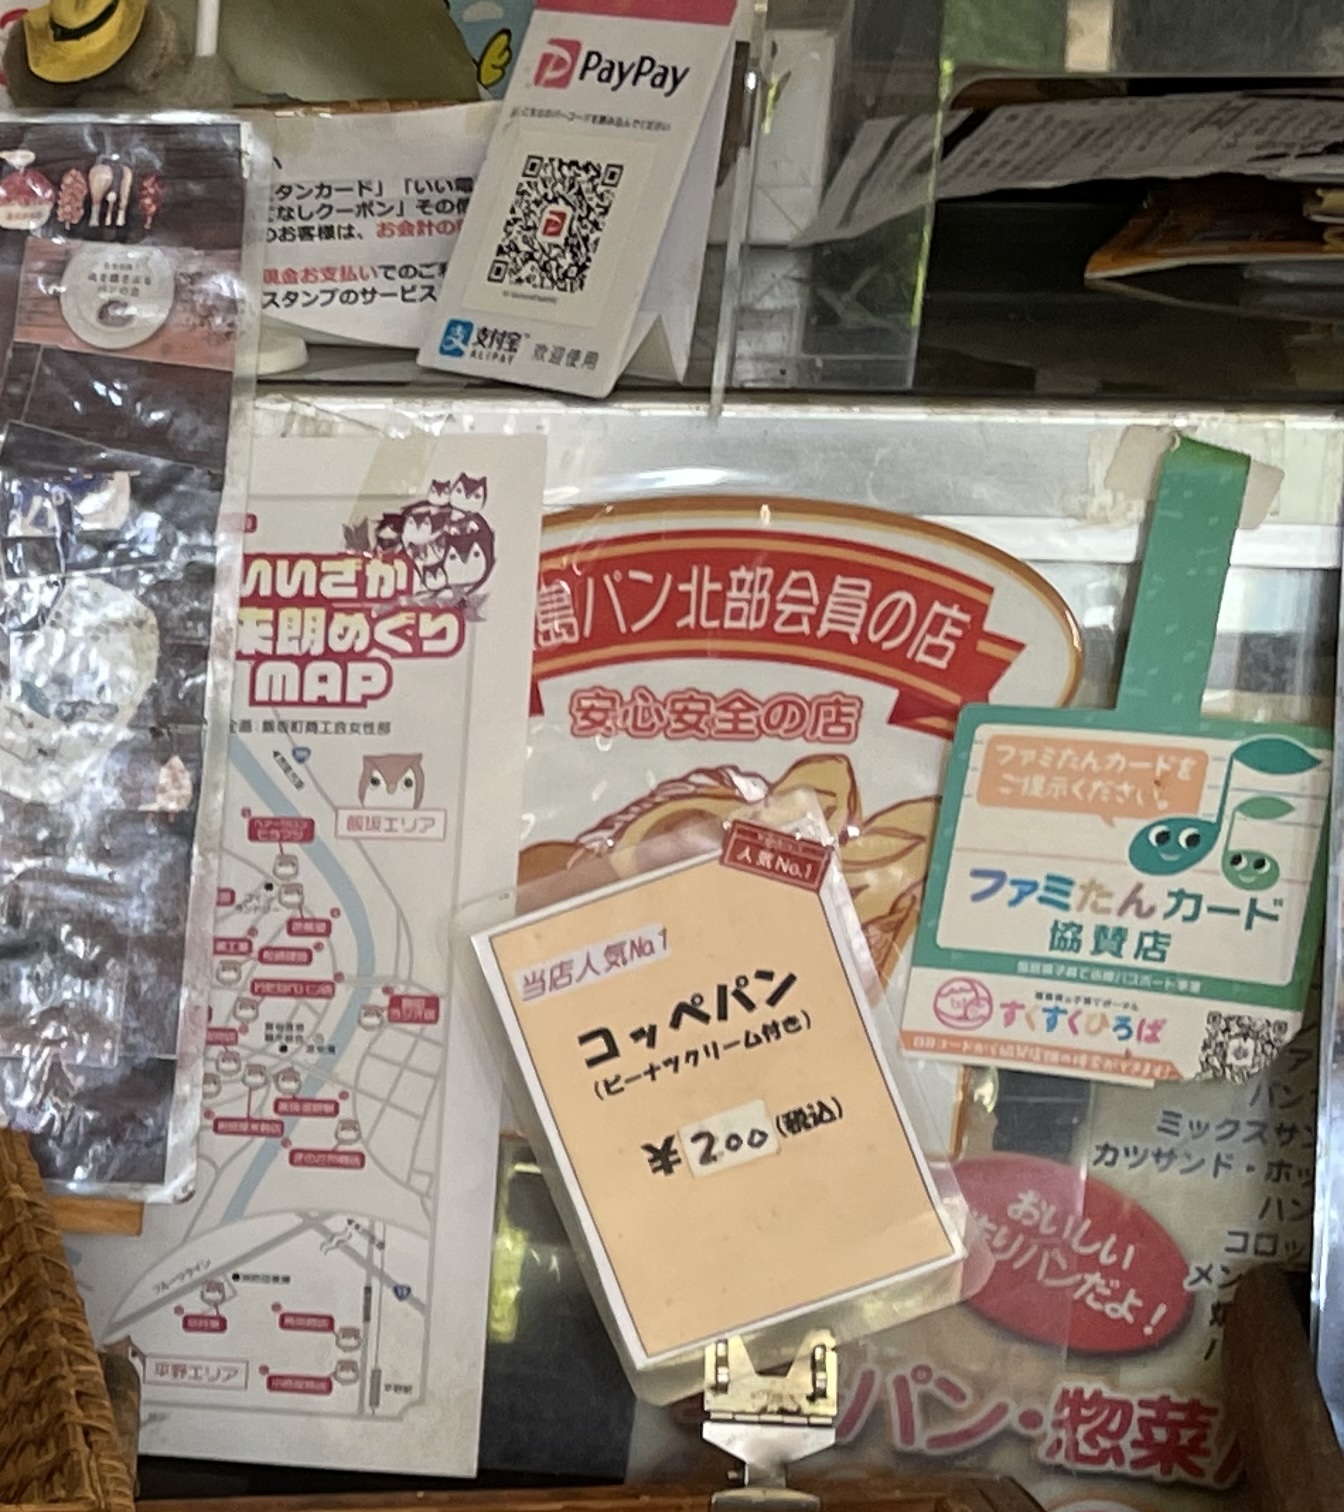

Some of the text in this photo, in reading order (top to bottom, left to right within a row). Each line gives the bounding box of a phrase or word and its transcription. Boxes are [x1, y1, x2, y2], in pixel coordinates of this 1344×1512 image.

[578, 50, 691, 98] PayPay
[262, 284, 438, 309] スタンプのサービス
[254, 661, 388, 703] MAP
[571, 687, 861, 744] 安心安全の店
[995, 743, 1197, 781] ファミたんカードを
[968, 867, 1285, 932] ファミたんカード
[1048, 919, 1173, 963] 協賛店
[576, 968, 799, 1069] コッペパン
[999, 1000, 1167, 1044] すくすくひろば
[1006, 1188, 1136, 1271] おいしい
[835, 1363, 1241, 1483] パン・惣菜
